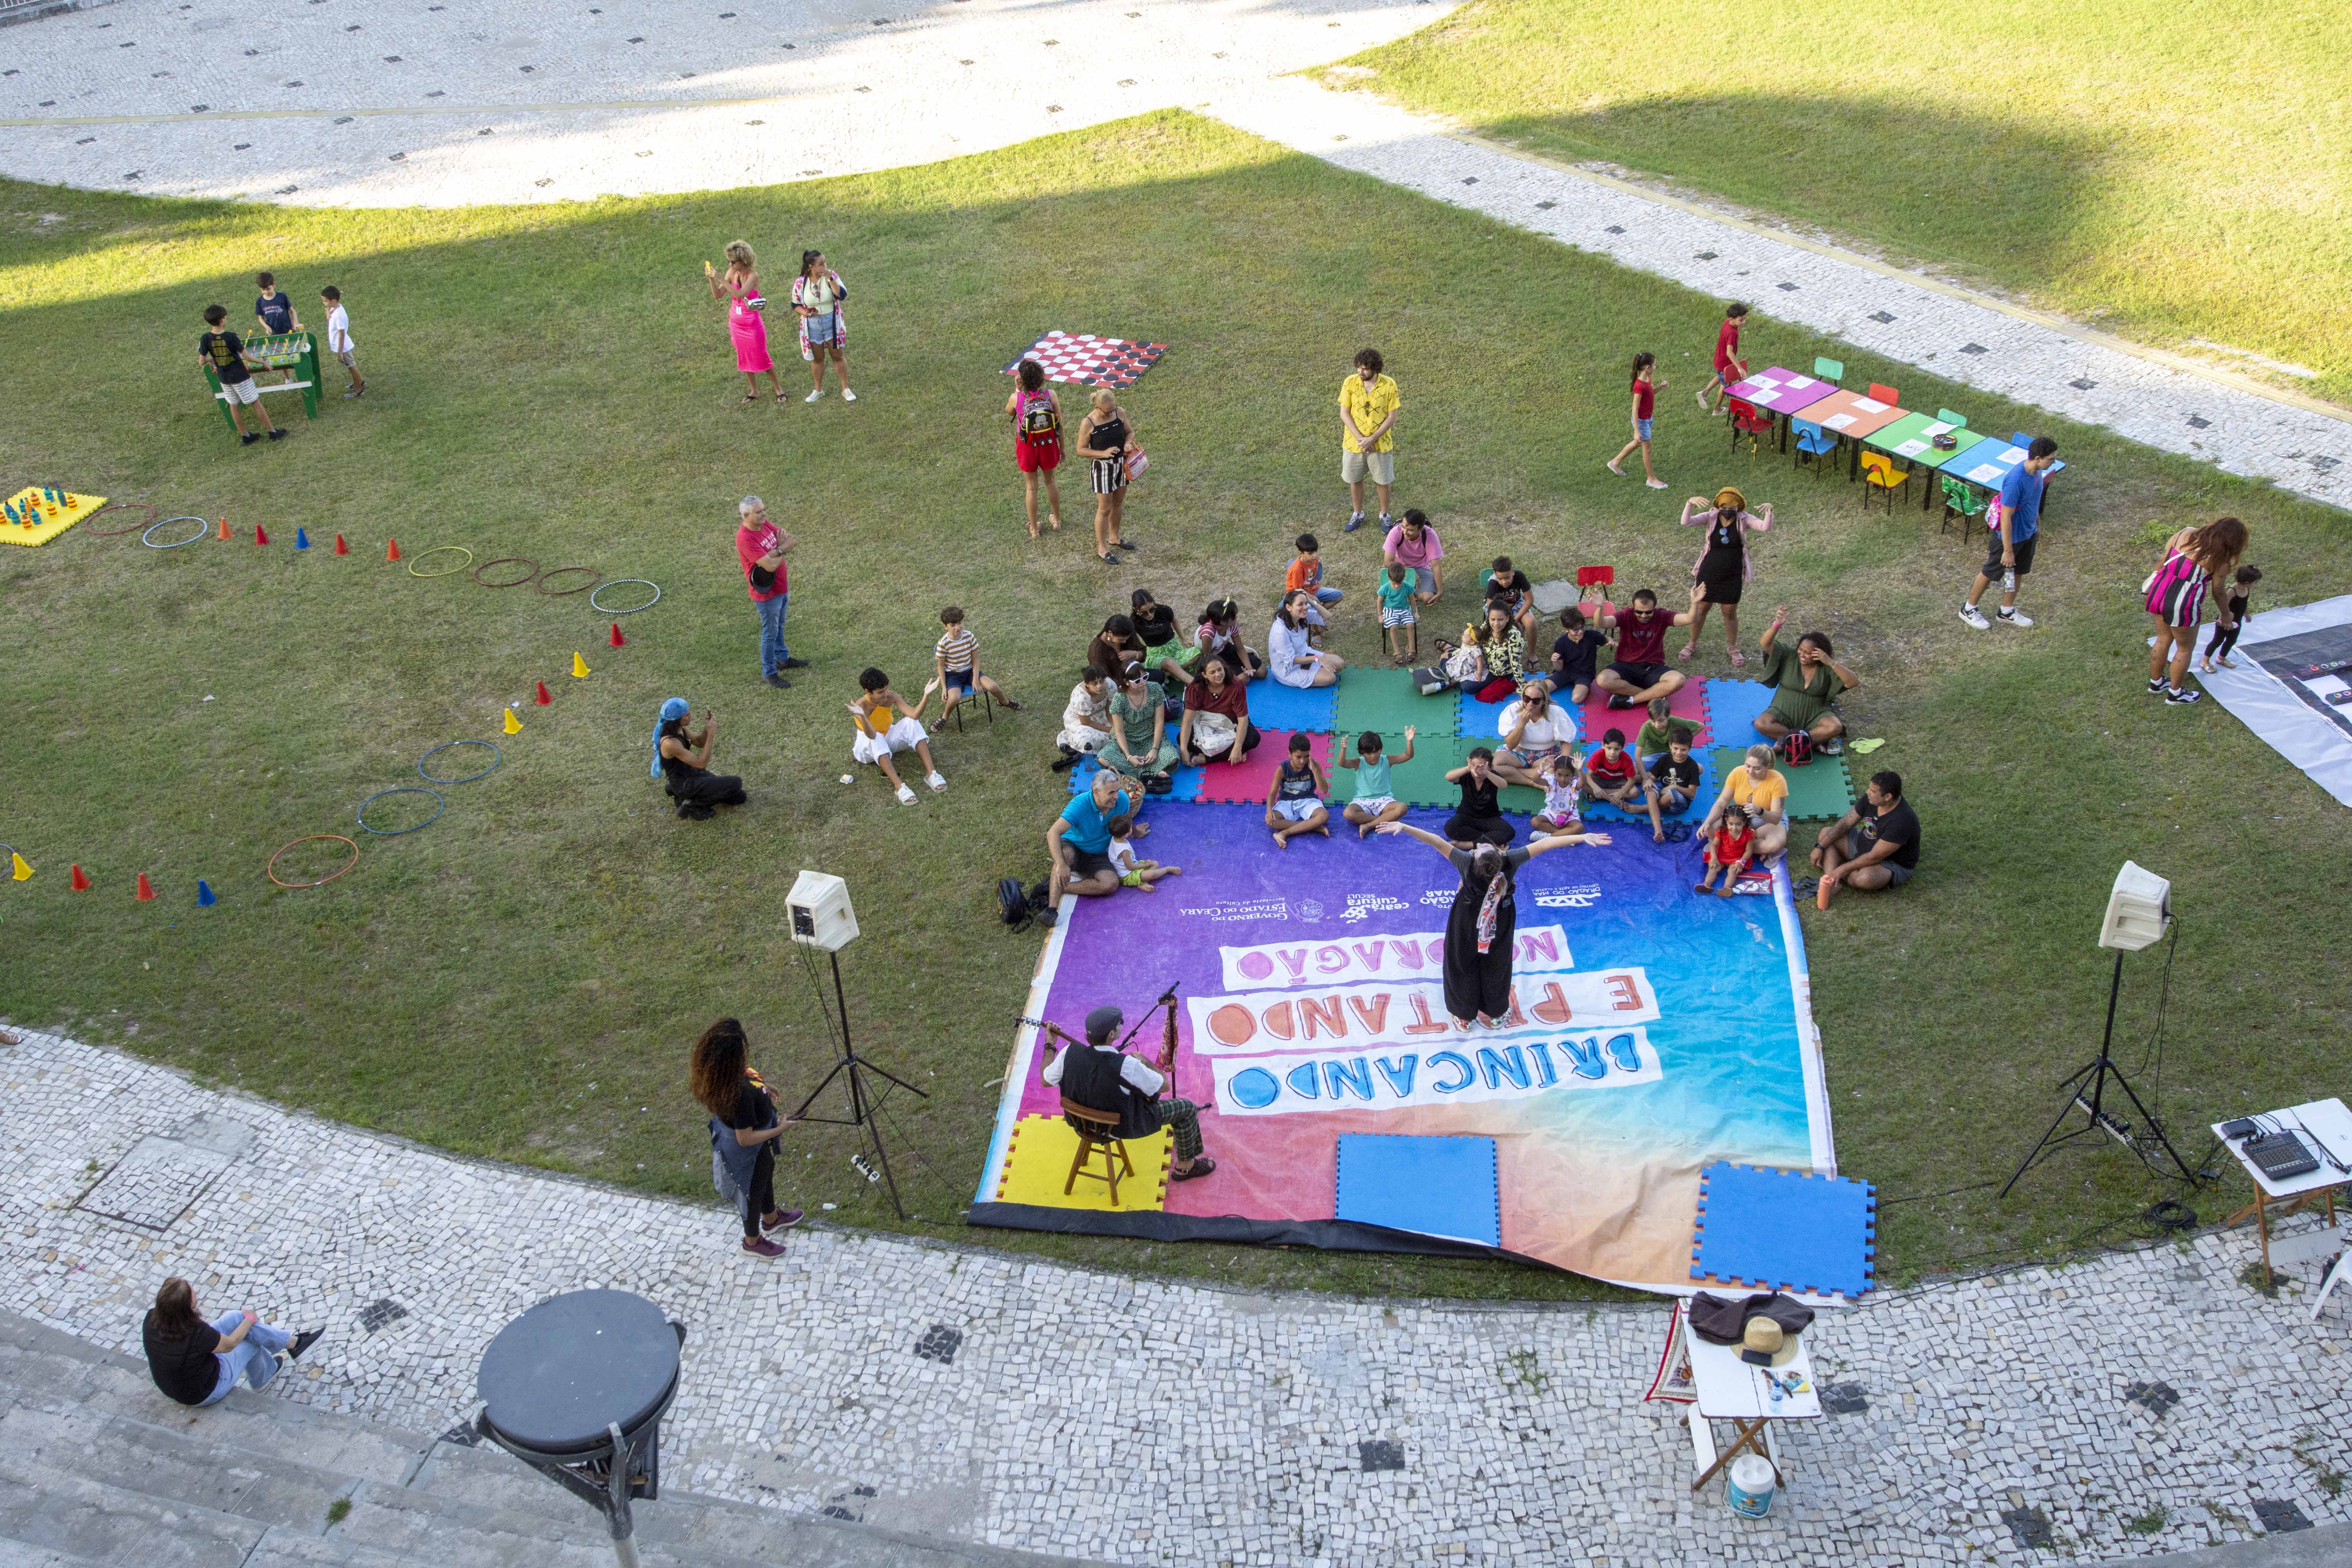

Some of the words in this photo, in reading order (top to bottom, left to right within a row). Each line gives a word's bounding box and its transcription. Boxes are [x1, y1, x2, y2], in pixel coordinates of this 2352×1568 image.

[1347, 897, 1398, 906] cultura
[1180, 907, 1221, 916] CEARÁ
[1240, 903, 1286, 912] ESTADO
[1372, 902, 1410, 912] ceará
[1228, 913, 1288, 921] GOVERNO
[1512, 930, 1560, 962] N
[1603, 974, 1644, 1011] E
[1229, 1031, 1642, 1109] BRINCANDO
